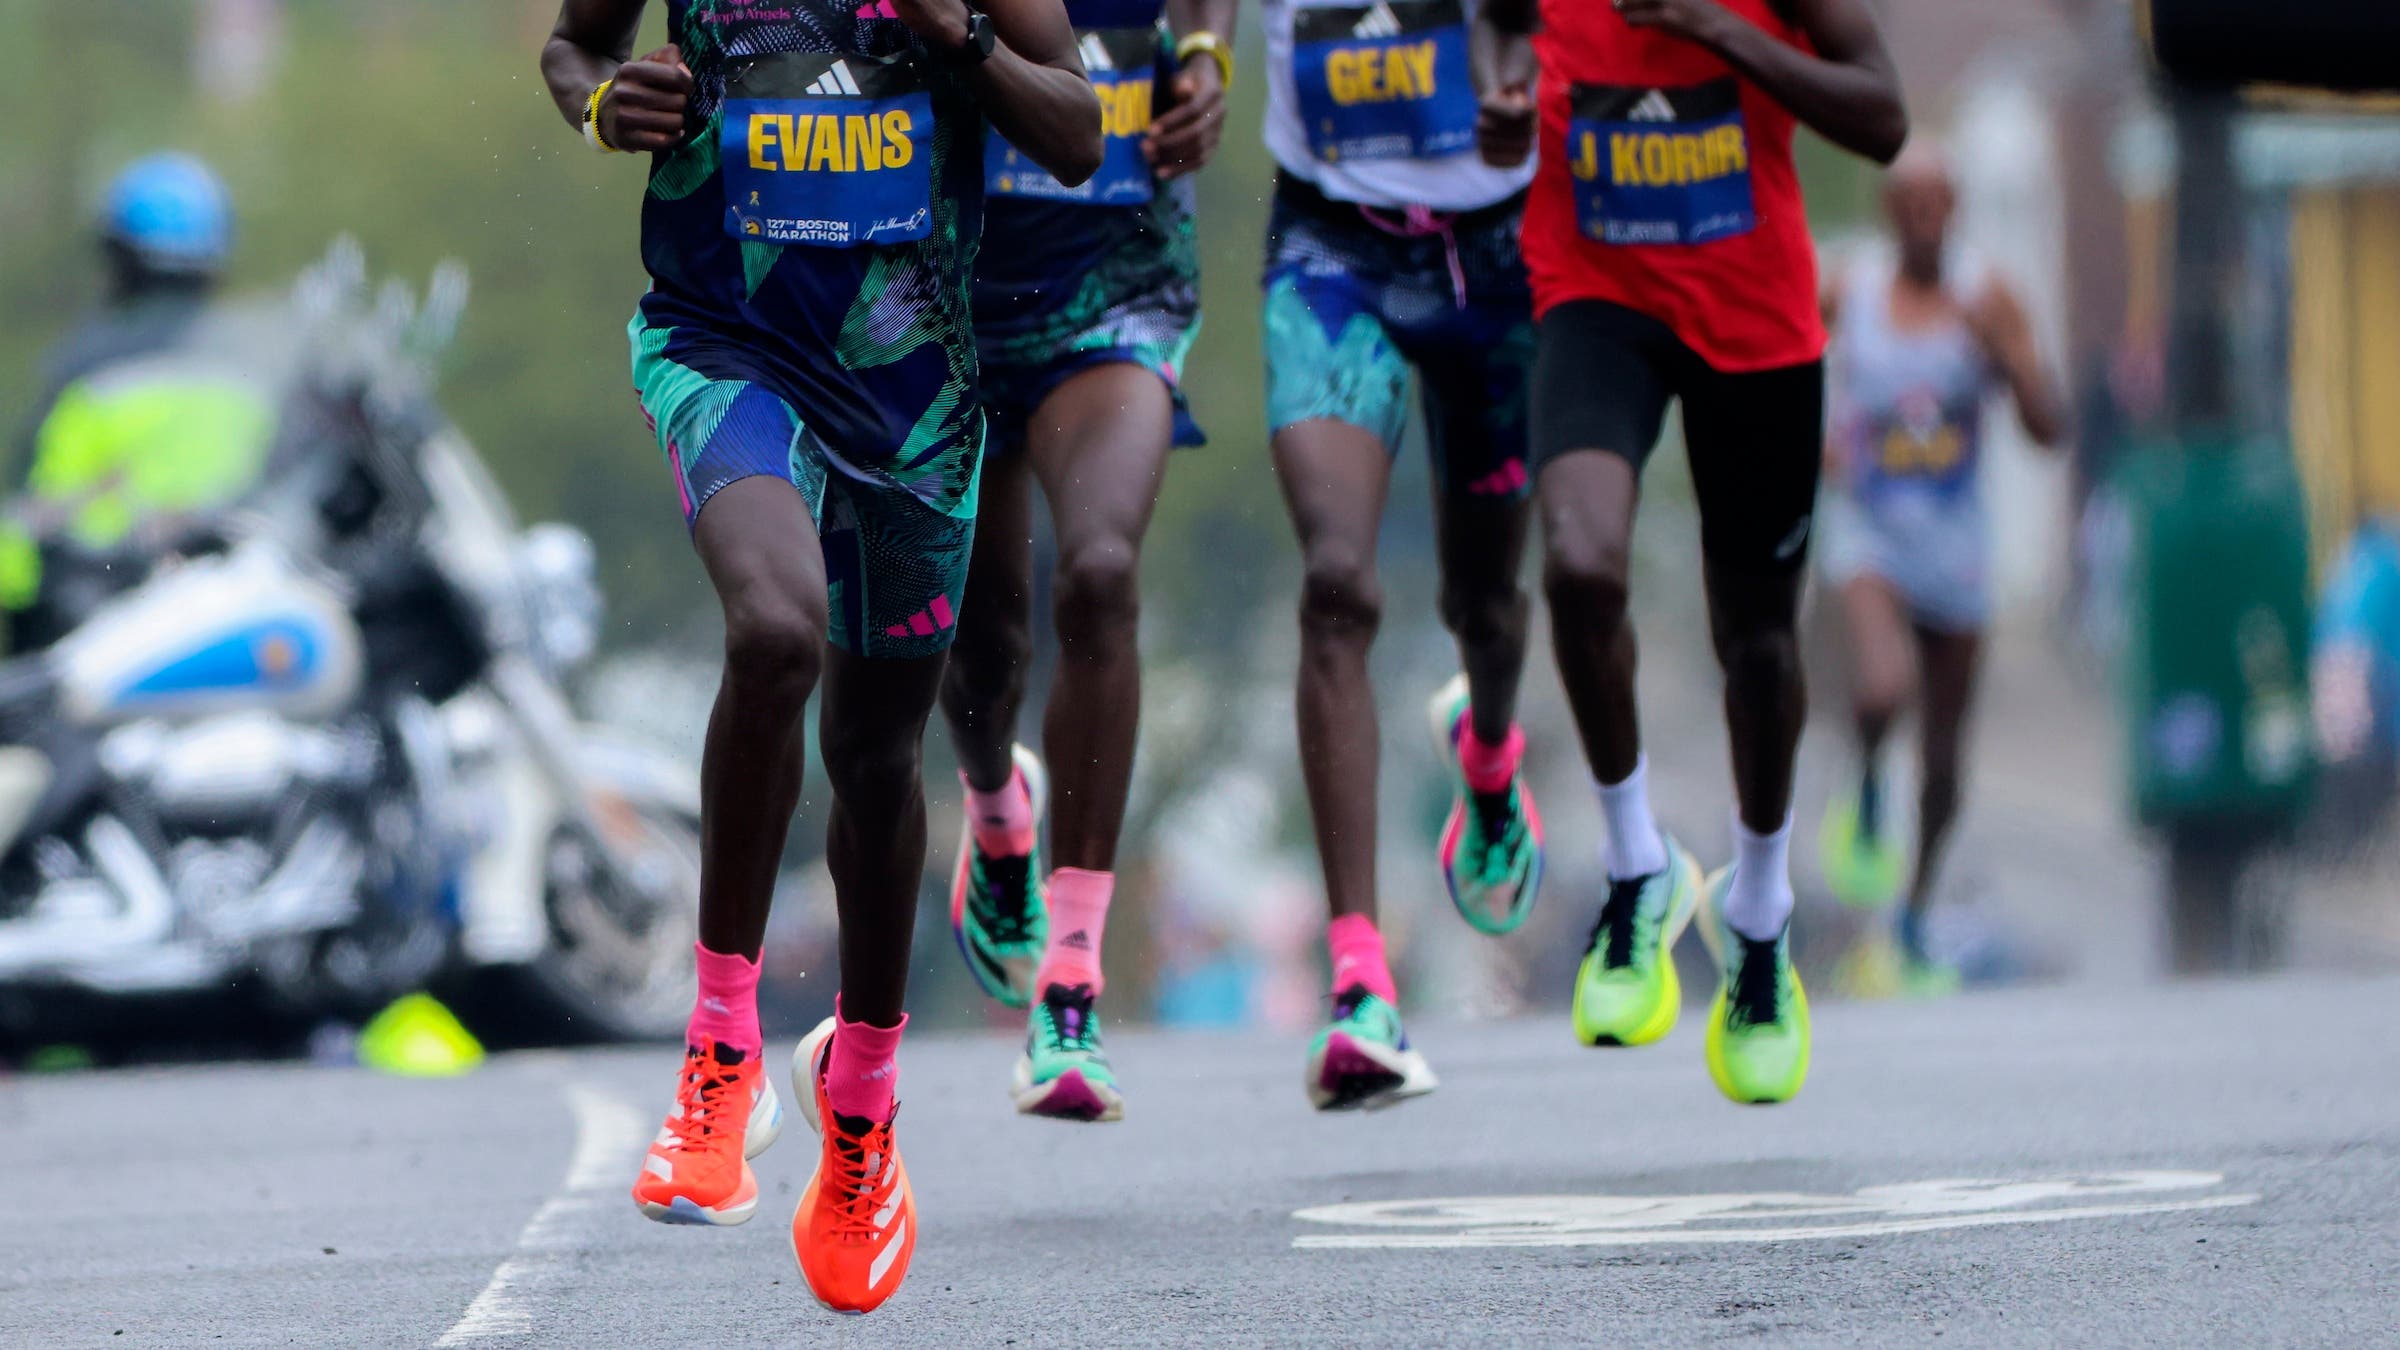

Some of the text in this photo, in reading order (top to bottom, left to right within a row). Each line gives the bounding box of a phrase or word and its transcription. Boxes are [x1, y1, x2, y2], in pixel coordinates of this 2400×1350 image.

[746, 8, 791, 20] Angels
[1325, 39, 1438, 106] GEAY
[748, 109, 913, 172] EVANS
[1571, 123, 1747, 187] J KORIR
[766, 218, 848, 231] 127TH BOSTON
[767, 229, 849, 242] MARATHON
